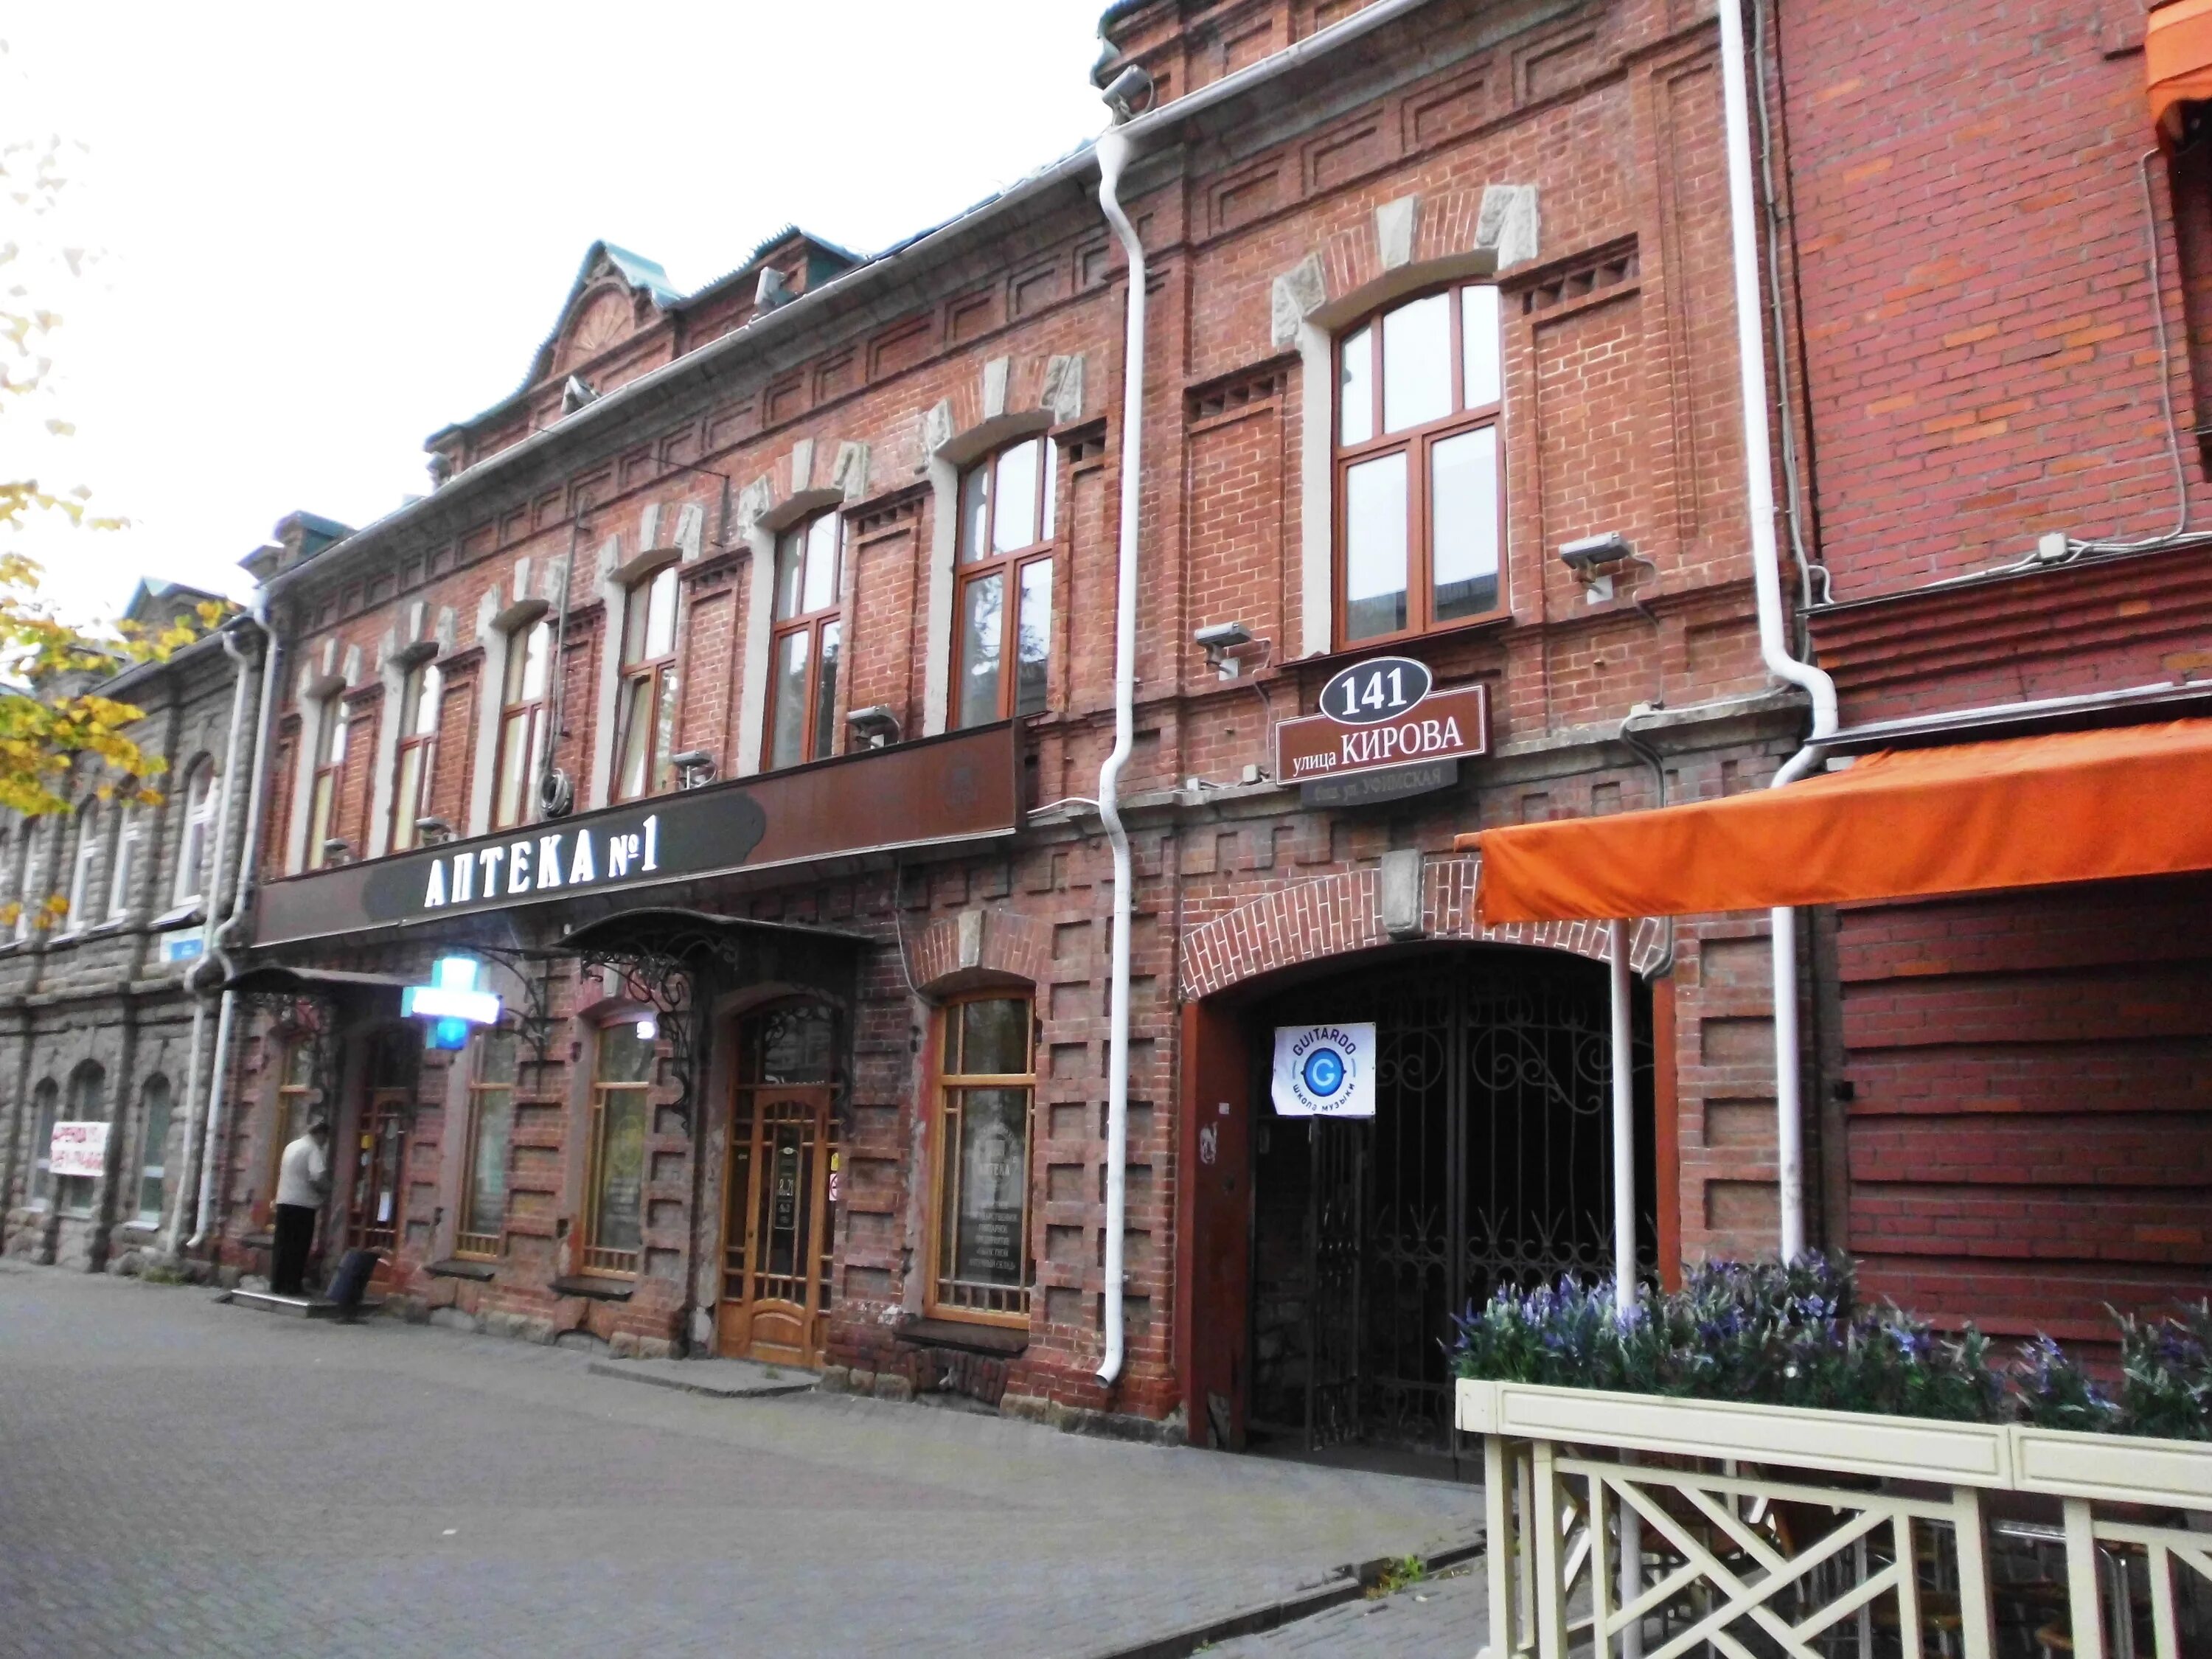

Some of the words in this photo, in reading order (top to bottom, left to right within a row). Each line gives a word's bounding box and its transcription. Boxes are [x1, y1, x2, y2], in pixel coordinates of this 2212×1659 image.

[1341, 667, 1407, 715] 141
[1293, 751, 1337, 776] улица
[1340, 716, 1464, 765] КИРОВА
[1363, 767, 1441, 794] УФИМСКАЯ
[424, 829, 594, 907] АПТЕКА
[1293, 1028, 1356, 1056] GUITARDO
[1312, 1059, 1335, 1086] G
